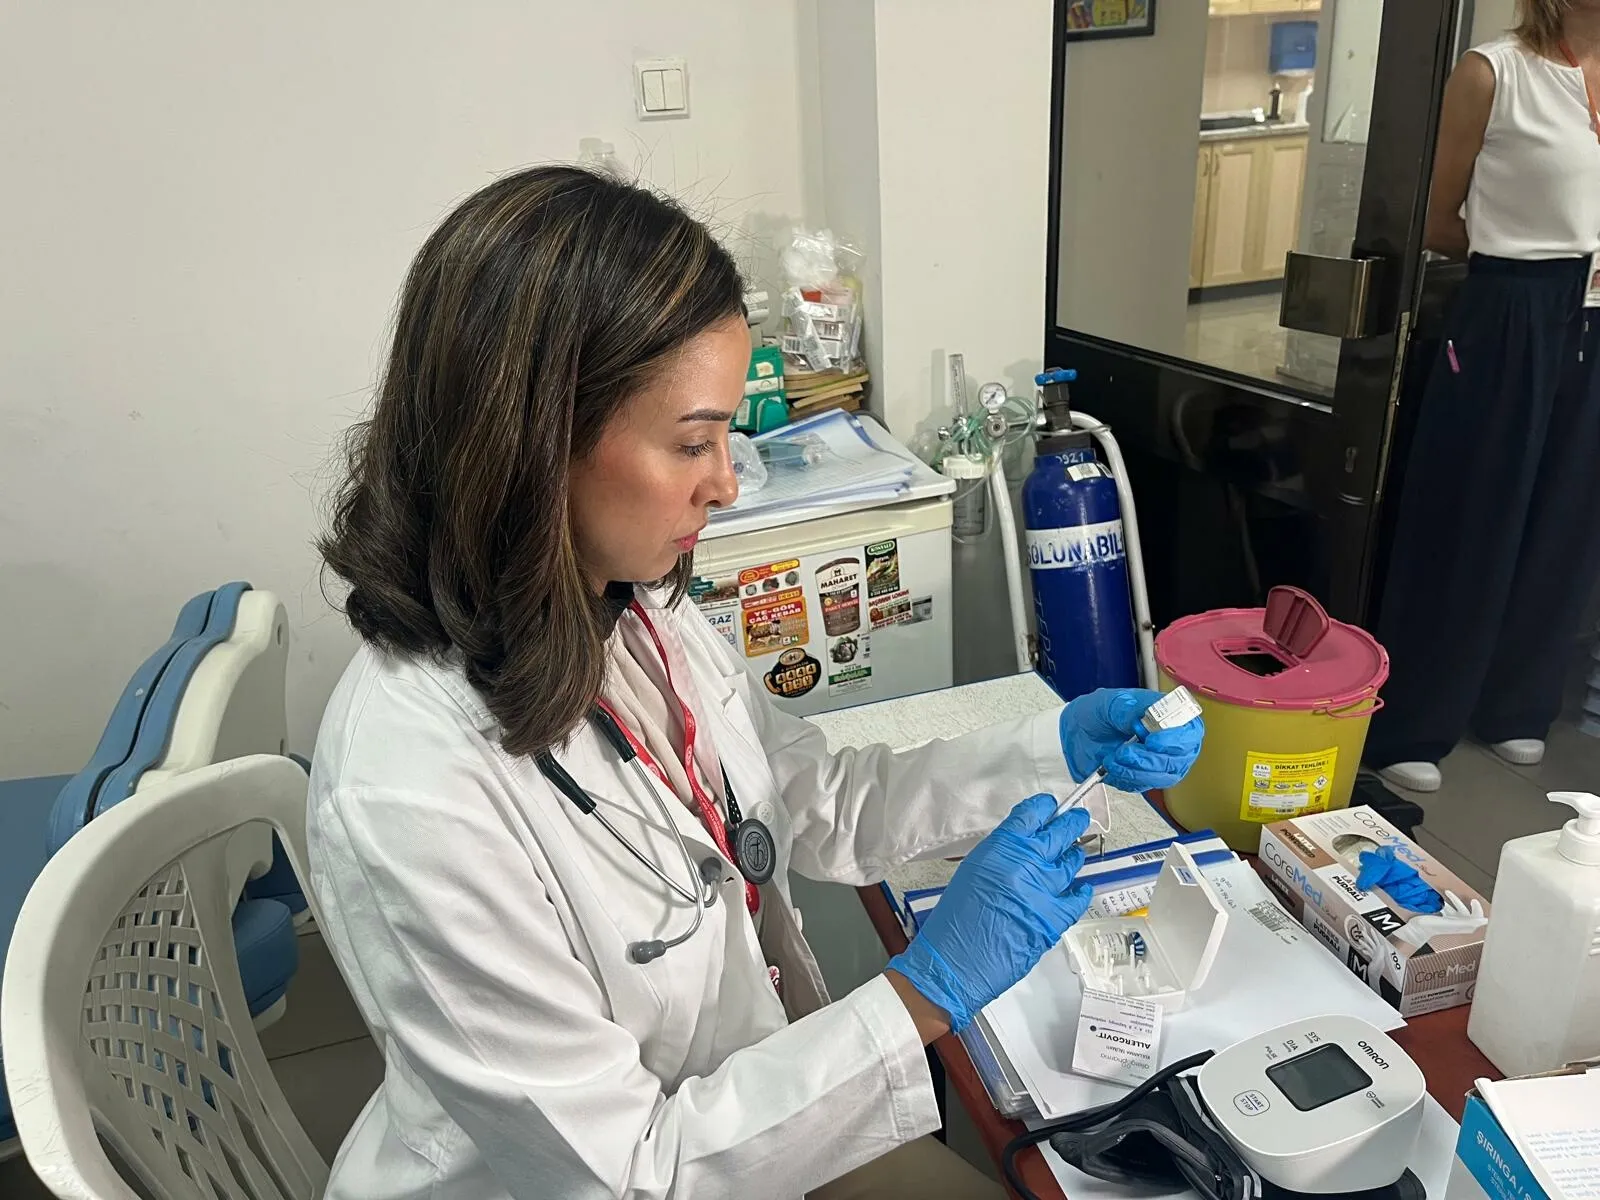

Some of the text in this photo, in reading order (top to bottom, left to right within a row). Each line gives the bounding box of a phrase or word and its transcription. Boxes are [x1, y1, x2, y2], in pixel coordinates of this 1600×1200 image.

[1264, 842, 1323, 907] CoreMed
[1331, 875, 1364, 902] PUDRALI
[1371, 913, 1401, 931] M
[1353, 954, 1368, 981] M
[1390, 951, 1401, 971] 100
[1414, 959, 1477, 984] CoreMed
[1098, 1032, 1151, 1049] ALLERGOVIT
[1286, 1039, 1299, 1051] DIA
[1308, 1031, 1321, 1042] SYS
[1357, 1040, 1390, 1070] OMRON
[1240, 1098, 1254, 1111] STOP
[1249, 1093, 1264, 1108] START
